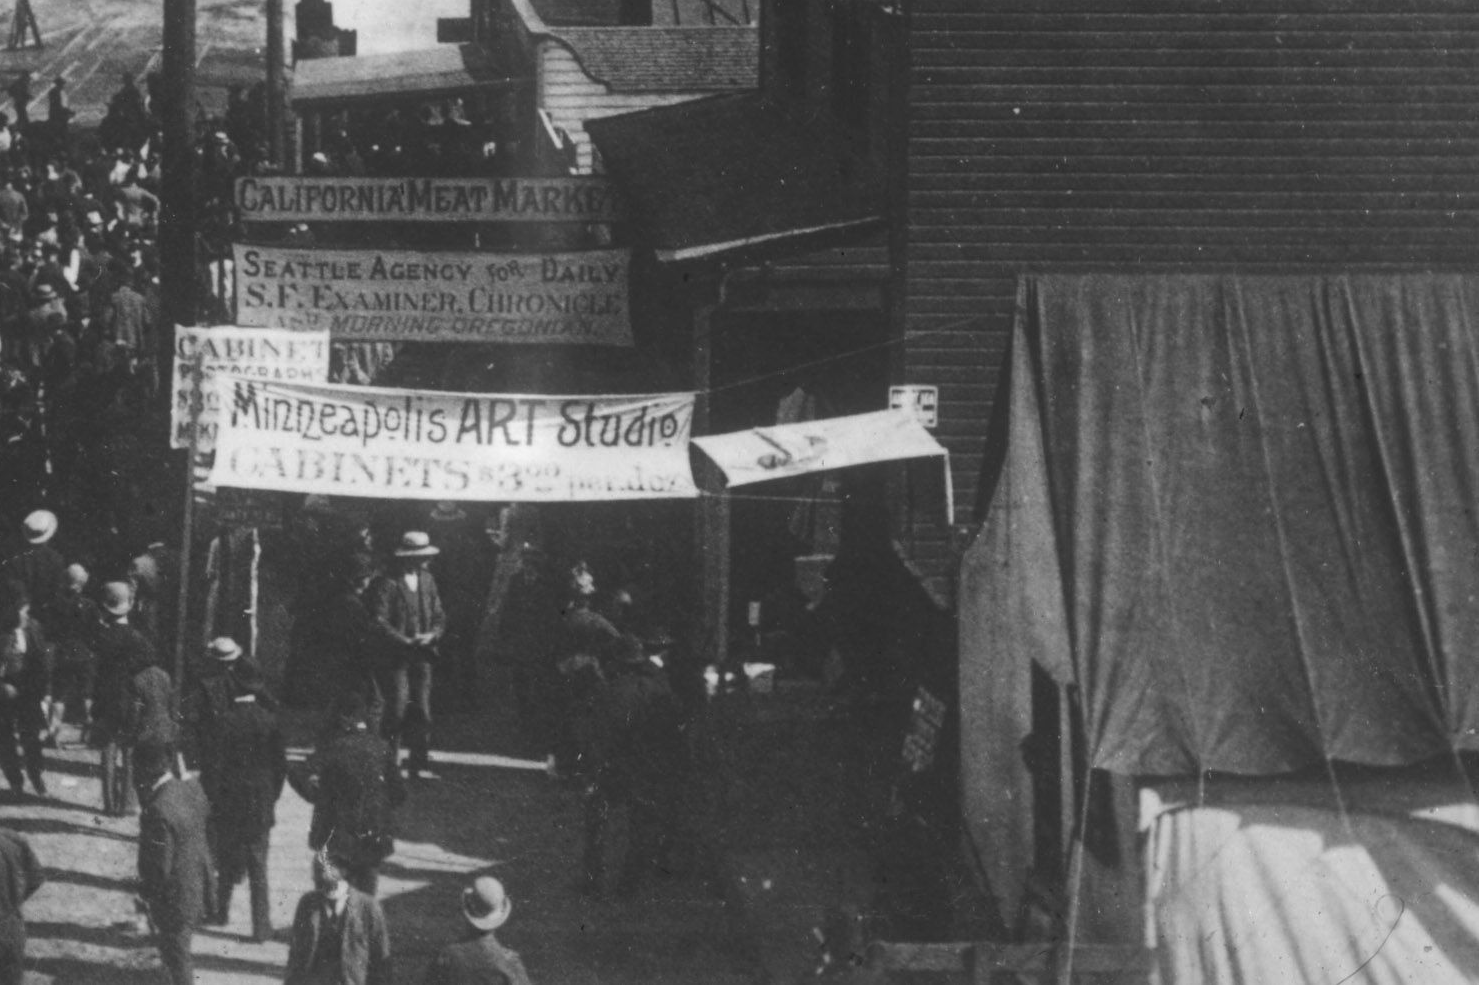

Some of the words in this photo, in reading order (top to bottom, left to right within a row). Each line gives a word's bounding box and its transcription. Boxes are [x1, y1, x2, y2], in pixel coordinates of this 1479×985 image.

[240, 178, 405, 213] CALIFORNIA
[407, 179, 488, 214] MEAT
[493, 179, 613, 214] MARKE
[243, 249, 362, 280] SEATTLE
[369, 254, 472, 282] AGENCY
[541, 257, 619, 283] DAILY
[245, 282, 304, 309] S.F.
[331, 315, 442, 336] MORNING
[231, 381, 447, 448] Minneapolis
[456, 398, 546, 447] ART
[556, 400, 679, 448] Studio
[229, 446, 471, 491] CABINETS
